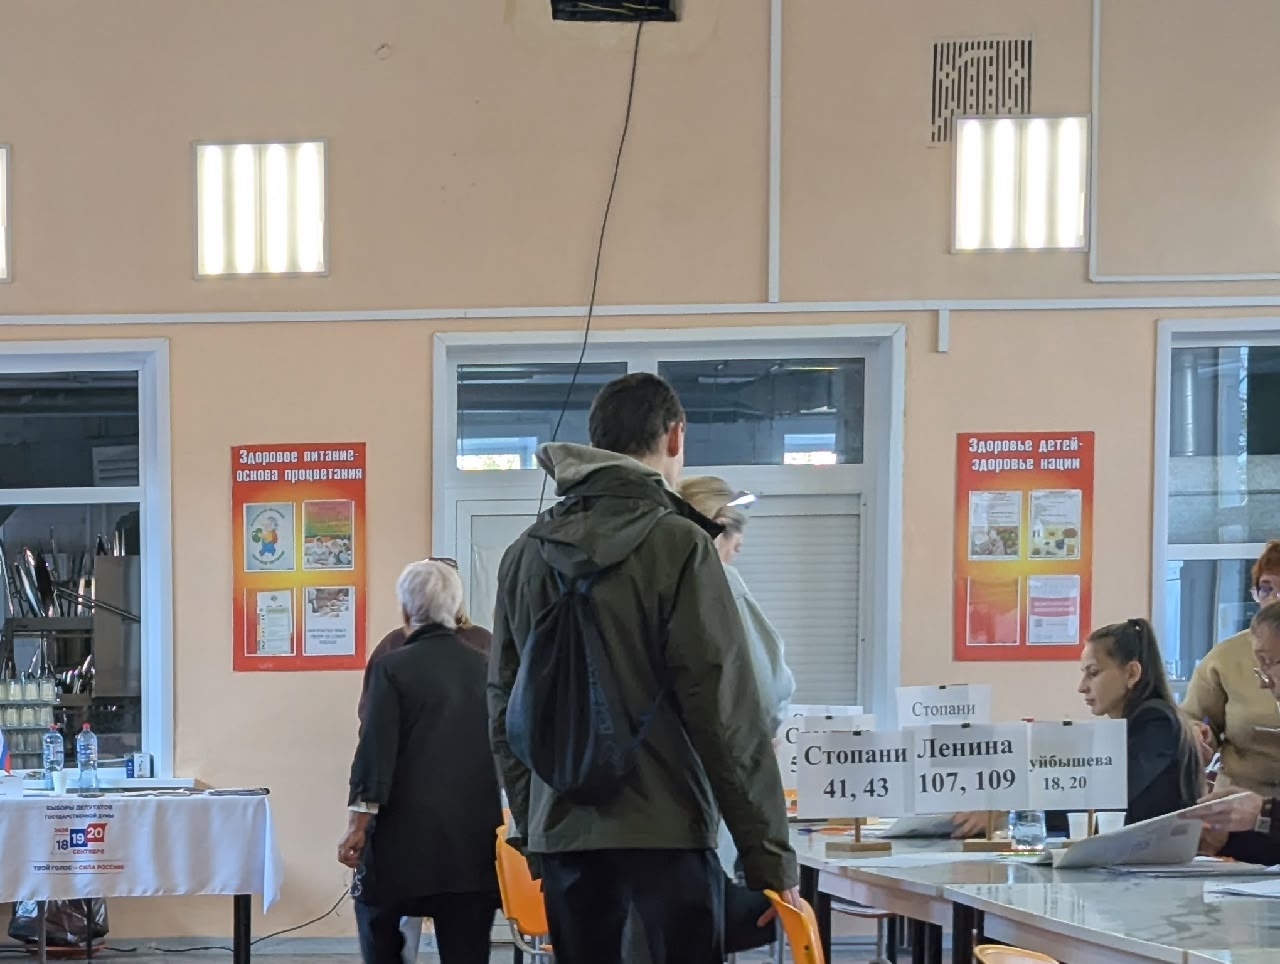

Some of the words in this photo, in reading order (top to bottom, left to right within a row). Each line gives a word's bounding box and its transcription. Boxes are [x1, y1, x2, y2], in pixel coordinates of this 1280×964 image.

[969, 438, 1032, 454] Здоровье
[1038, 437, 1083, 452] детей-
[240, 450, 297, 465] Здоровое
[304, 450, 358, 462] питание-
[972, 458, 1033, 472] здоровье
[1040, 458, 1079, 470] нации
[237, 469, 278, 481] основа
[285, 468, 361, 483] процветания
[911, 702, 976, 717] Стопани
[804, 746, 907, 765] Стопани
[917, 738, 1014, 758] Ленина
[1029, 755, 1113, 772] уйбышева
[823, 779, 856, 802] 41,
[863, 778, 889, 797] 43
[920, 772, 967, 796] 107,
[976, 769, 1016, 790] 109
[1043, 777, 1065, 791] 18,
[1070, 776, 1087, 789] 20
[72, 833, 85, 844] 19
[87, 828, 103, 839] 20
[56, 839, 69, 851] 18
